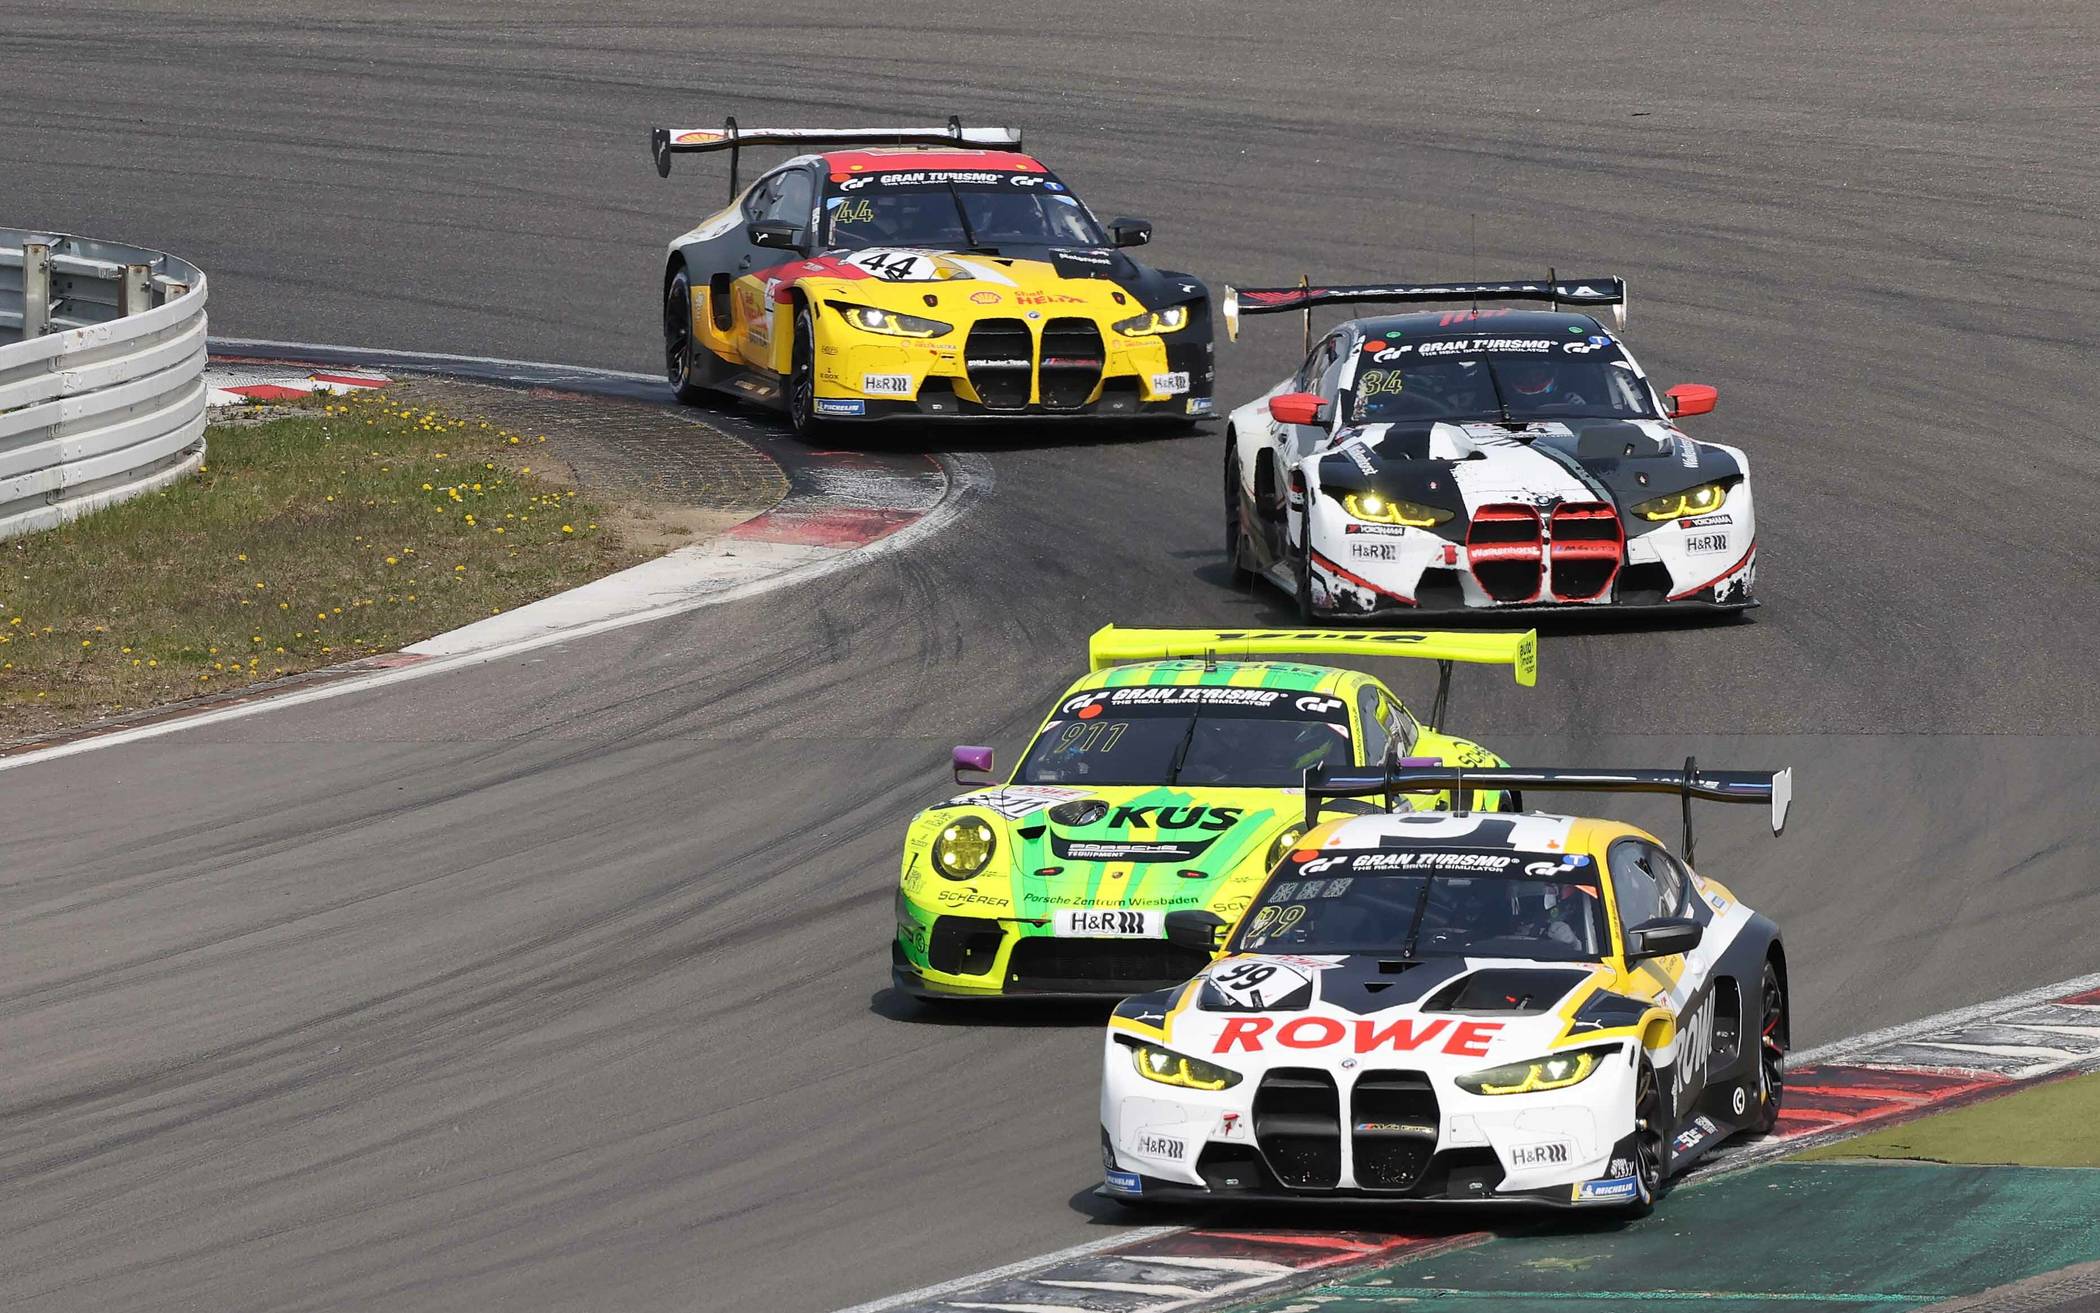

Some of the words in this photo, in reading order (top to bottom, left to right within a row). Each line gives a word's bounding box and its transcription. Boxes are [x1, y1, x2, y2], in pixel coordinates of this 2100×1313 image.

[880, 172, 925, 184] GRAN
[834, 199, 875, 224] 44
[860, 252, 919, 279] 44
[1418, 340, 1468, 354] GRAN
[1361, 370, 1402, 395] 34
[1112, 688, 1177, 700] GRAN
[1054, 721, 1129, 753] 911
[1067, 850, 1125, 858] TEQUIPMENT
[1352, 853, 1416, 867] GRAN
[938, 889, 1009, 908] SCHERER
[1024, 892, 1070, 905] Porsche
[1073, 896, 1126, 906] Zentrum
[1128, 896, 1199, 907] Wiesbaden
[1247, 904, 1307, 938] 99
[1216, 963, 1278, 991] 99
[1212, 1016, 1506, 1058] ROWE
[1595, 1182, 1633, 1195] MICHELIN
